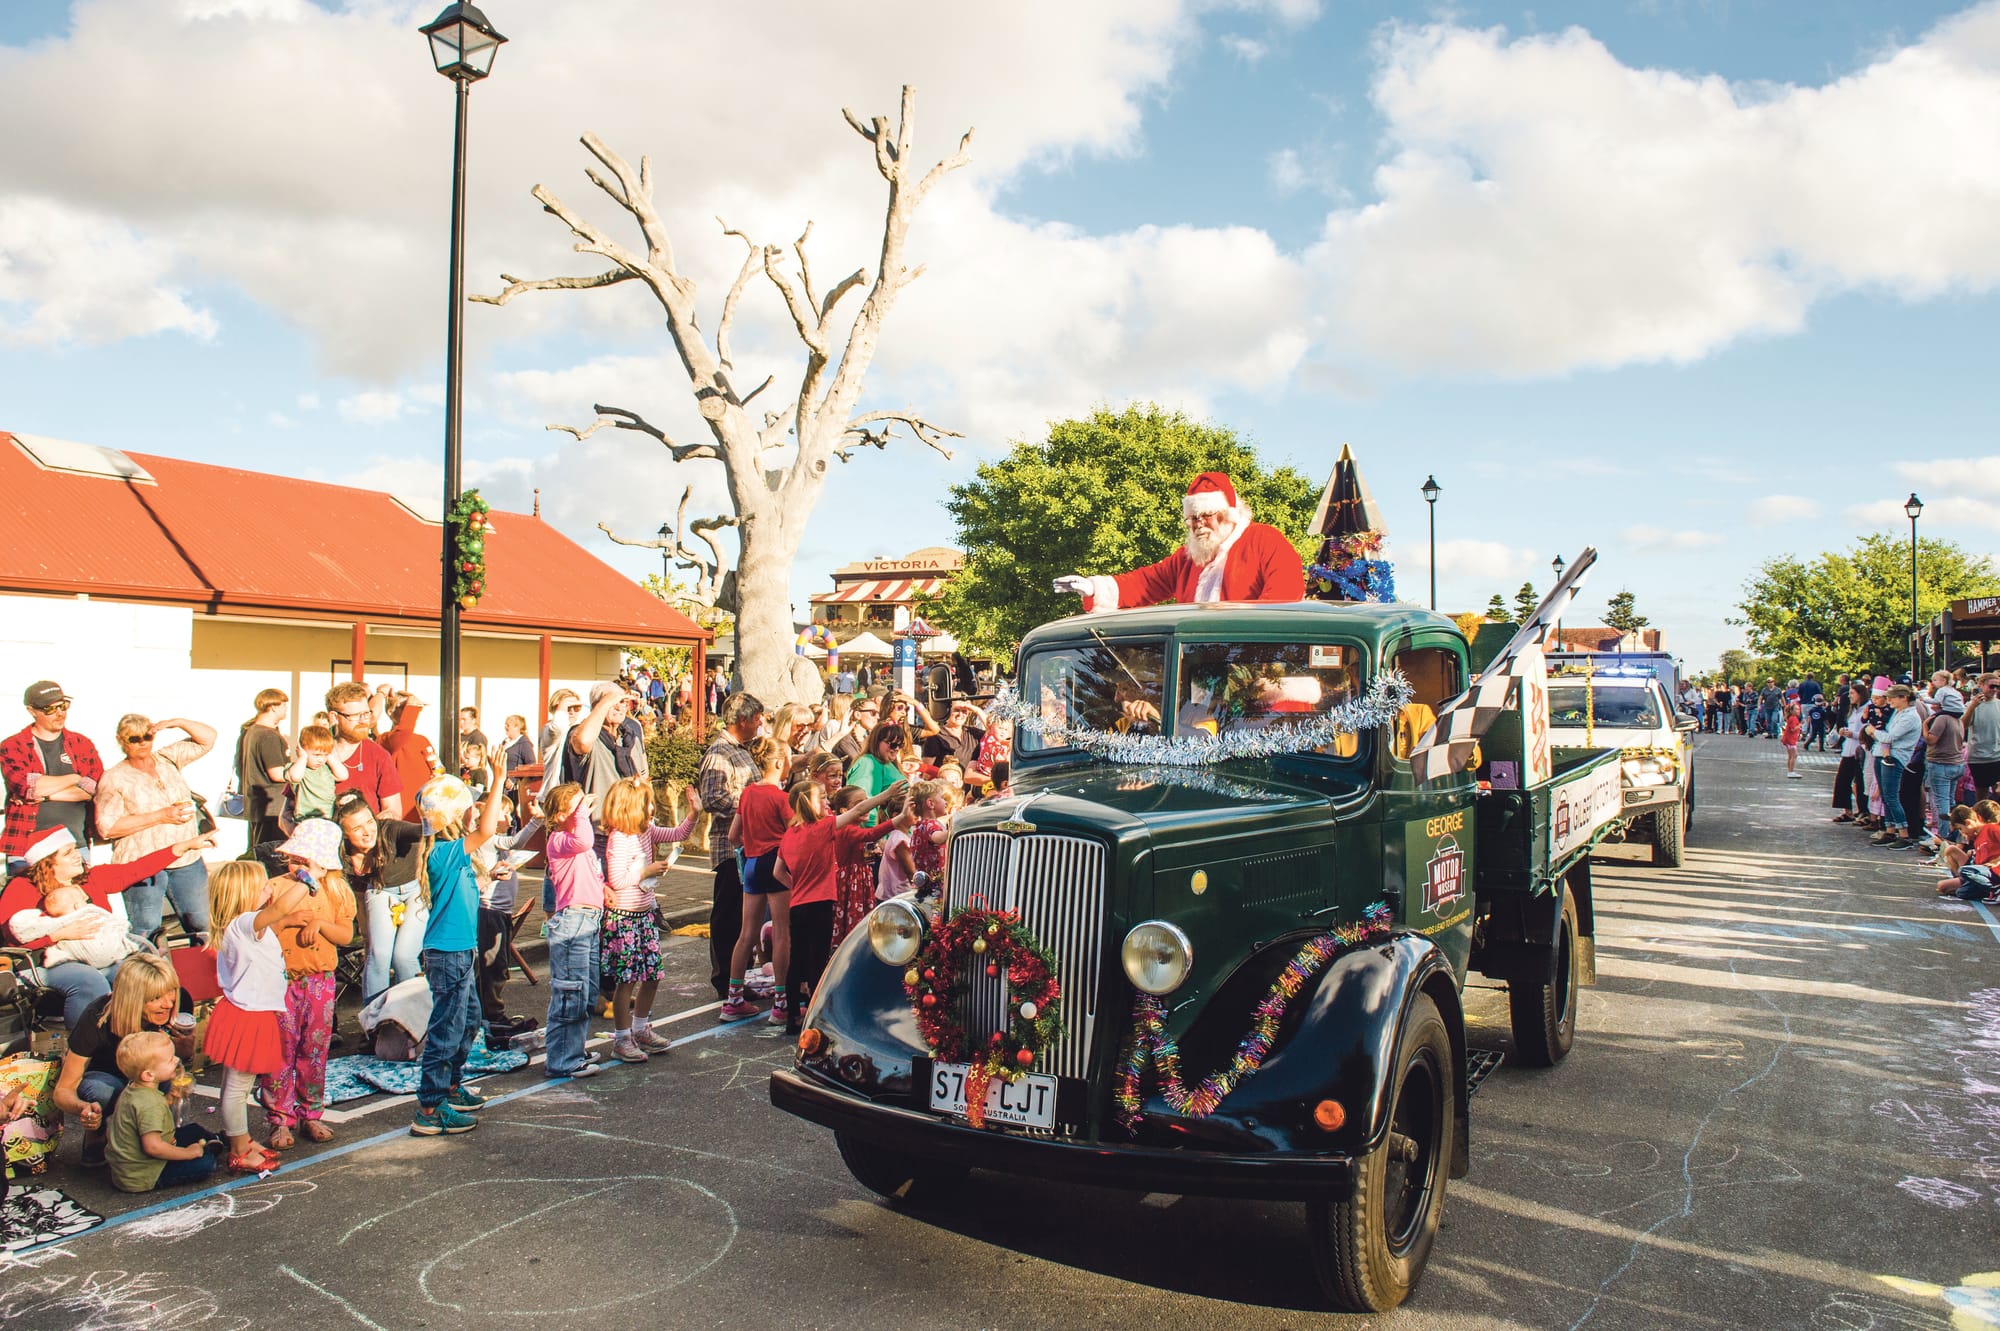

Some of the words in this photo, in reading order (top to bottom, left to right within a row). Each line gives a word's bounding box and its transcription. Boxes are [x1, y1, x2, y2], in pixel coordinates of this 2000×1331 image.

[864, 560, 939, 570] VICTORIA
[1967, 598, 1997, 614] HAMMER
[1426, 811, 1464, 838] GEORGE
[1433, 857, 1459, 885] MOTOR
[1437, 879, 1457, 897] MUSEUM
[982, 1110, 1027, 1122] AUSTRALIA
